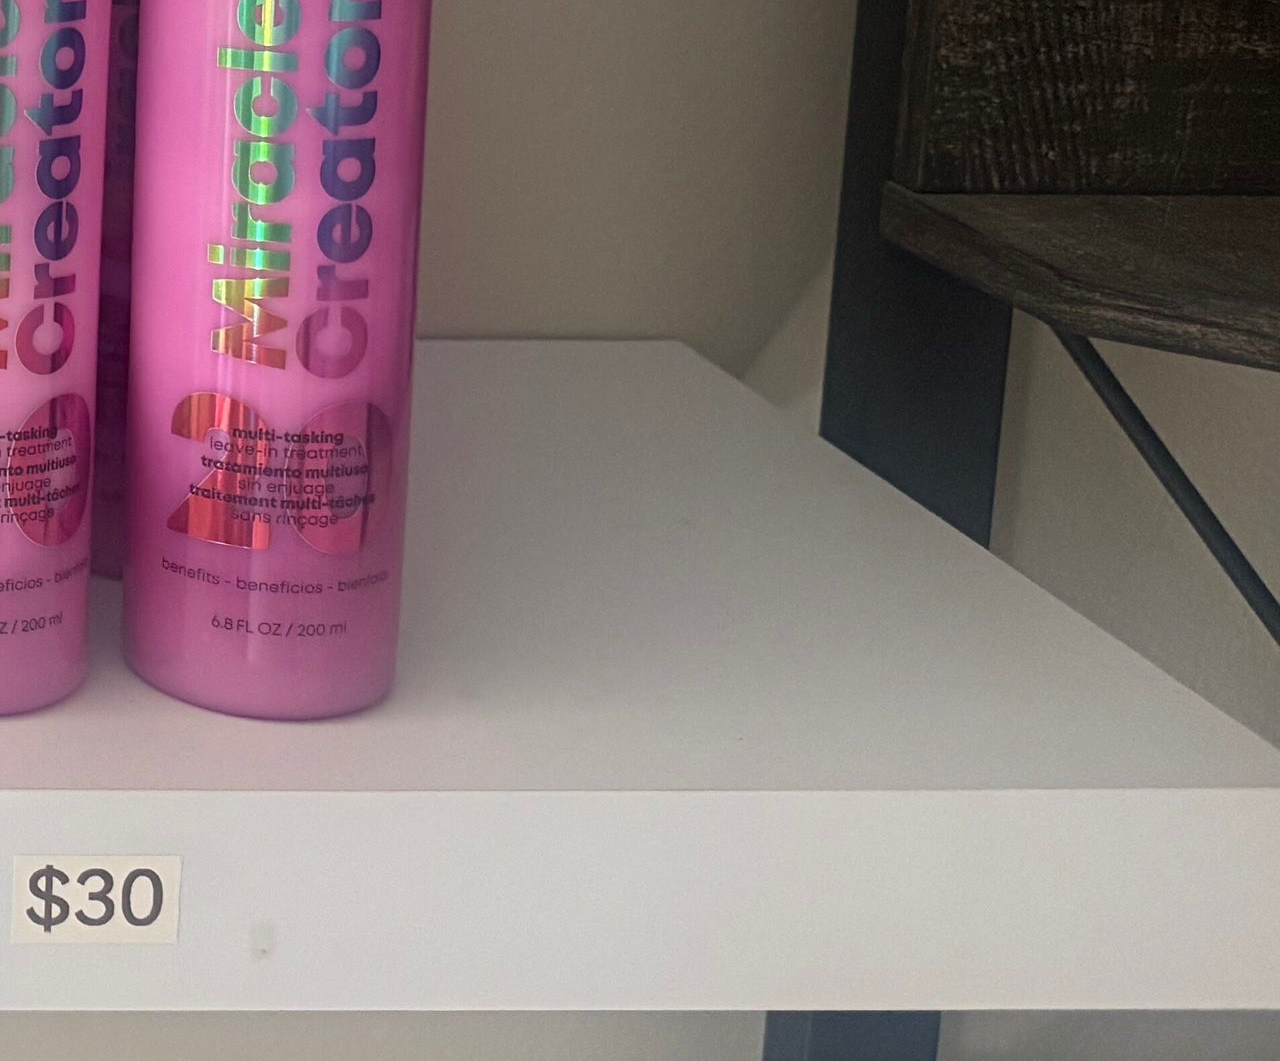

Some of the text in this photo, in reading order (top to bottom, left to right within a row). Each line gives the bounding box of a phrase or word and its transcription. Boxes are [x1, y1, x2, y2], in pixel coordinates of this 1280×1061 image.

[7, 437, 72, 458] treatment
[209, 436, 363, 459] leave-in treatment
[232, 427, 345, 446] multi-tasking
[26, 454, 77, 476] multiuso
[166, 391, 395, 555] 20
[200, 454, 369, 479] tratamiento multiuso
[189, 483, 277, 508] traitement
[238, 479, 336, 497] sin enjuage
[0, 505, 55, 526] rinçage
[230, 508, 339, 529] sans rinçage
[161, 556, 221, 585] benefits
[236, 576, 324, 594] beneficios
[21, 616, 46, 633] 200
[48, 610, 64, 627] ml
[211, 614, 233, 630] 6.8
[236, 619, 253, 634] FL
[258, 621, 282, 636] OZ
[297, 623, 326, 637] 200
[329, 621, 347, 635] ml
[25, 864, 164, 933] $30
